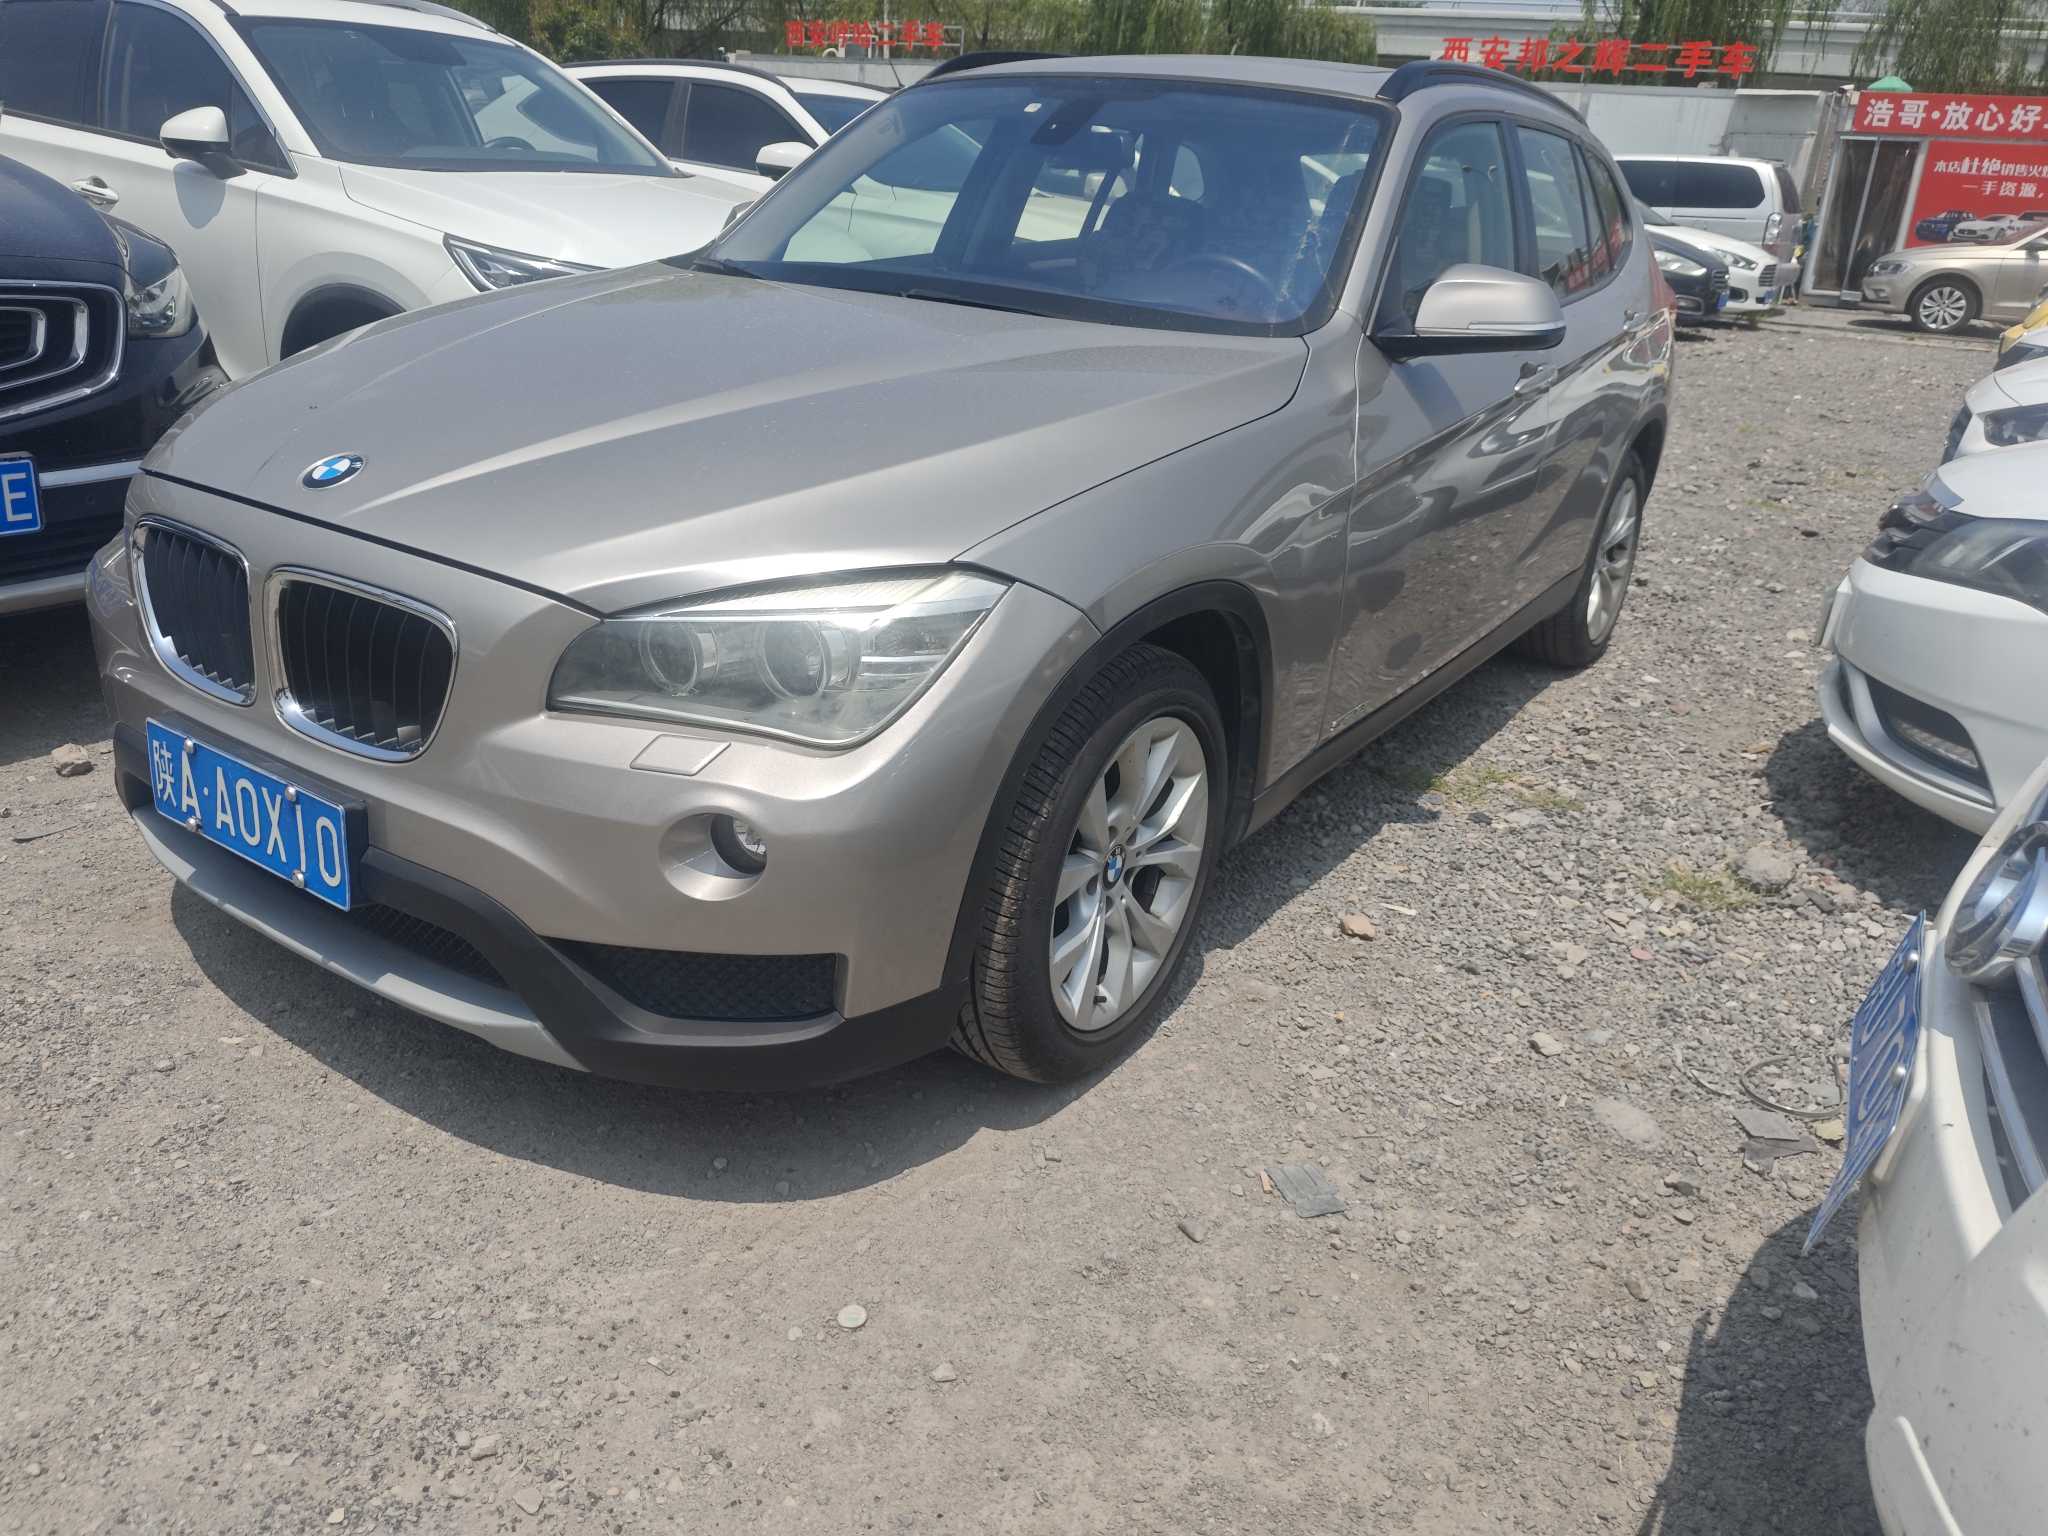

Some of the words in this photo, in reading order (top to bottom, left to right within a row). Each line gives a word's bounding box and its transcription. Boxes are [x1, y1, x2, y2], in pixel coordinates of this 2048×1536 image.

[1442, 36, 1757, 79] 西安邦之辉二手车
[1863, 98, 2048, 133] 浩哥·放心好
